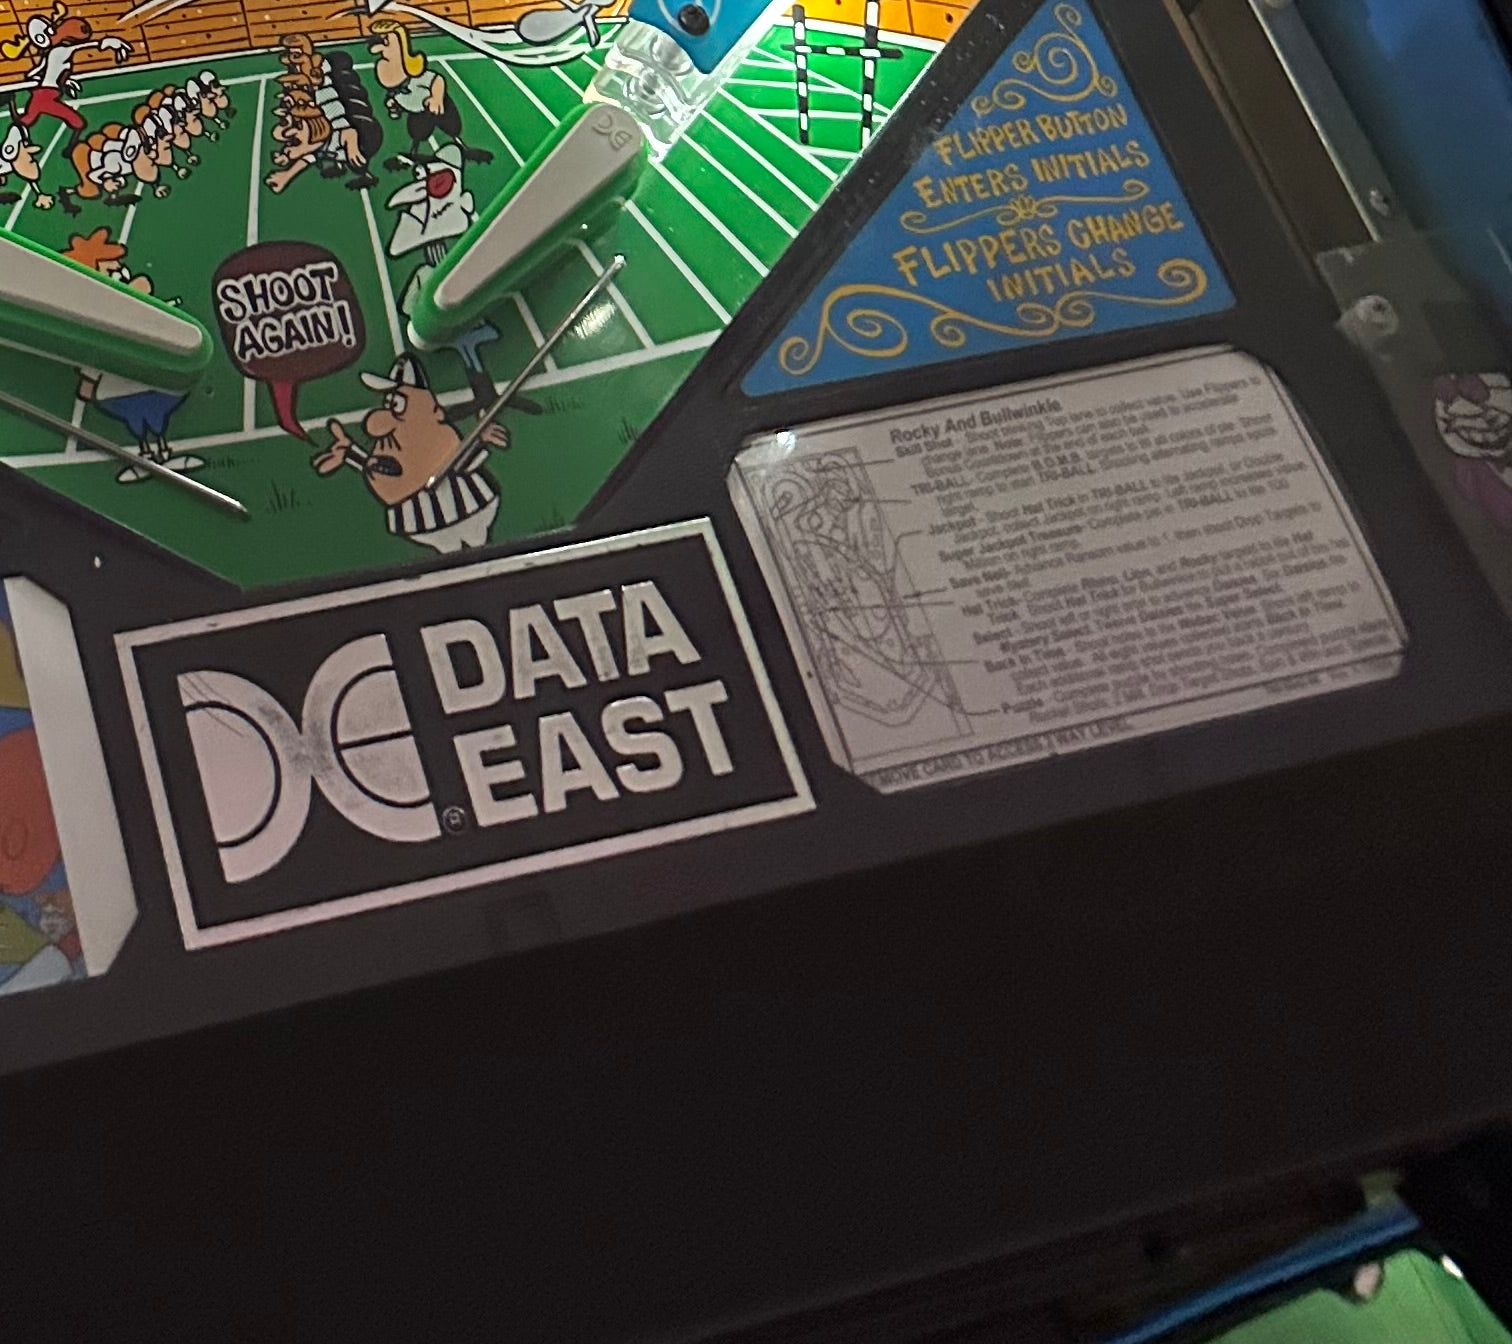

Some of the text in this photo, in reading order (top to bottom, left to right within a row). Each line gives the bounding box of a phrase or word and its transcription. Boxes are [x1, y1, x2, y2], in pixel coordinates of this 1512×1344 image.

[933, 101, 1132, 168] FLIPPER BUTTON
[913, 139, 1152, 211] ENTERS INITIALS
[893, 199, 1185, 292] FLIPPERS CHANGE
[986, 245, 1139, 306] INITIALS
[217, 261, 339, 322] SHOOT
[233, 303, 354, 364] AGAIN!
[889, 397, 1064, 445] Rocky And Bullwinkle
[419, 580, 702, 716] DATA
[451, 679, 729, 827] EAST
